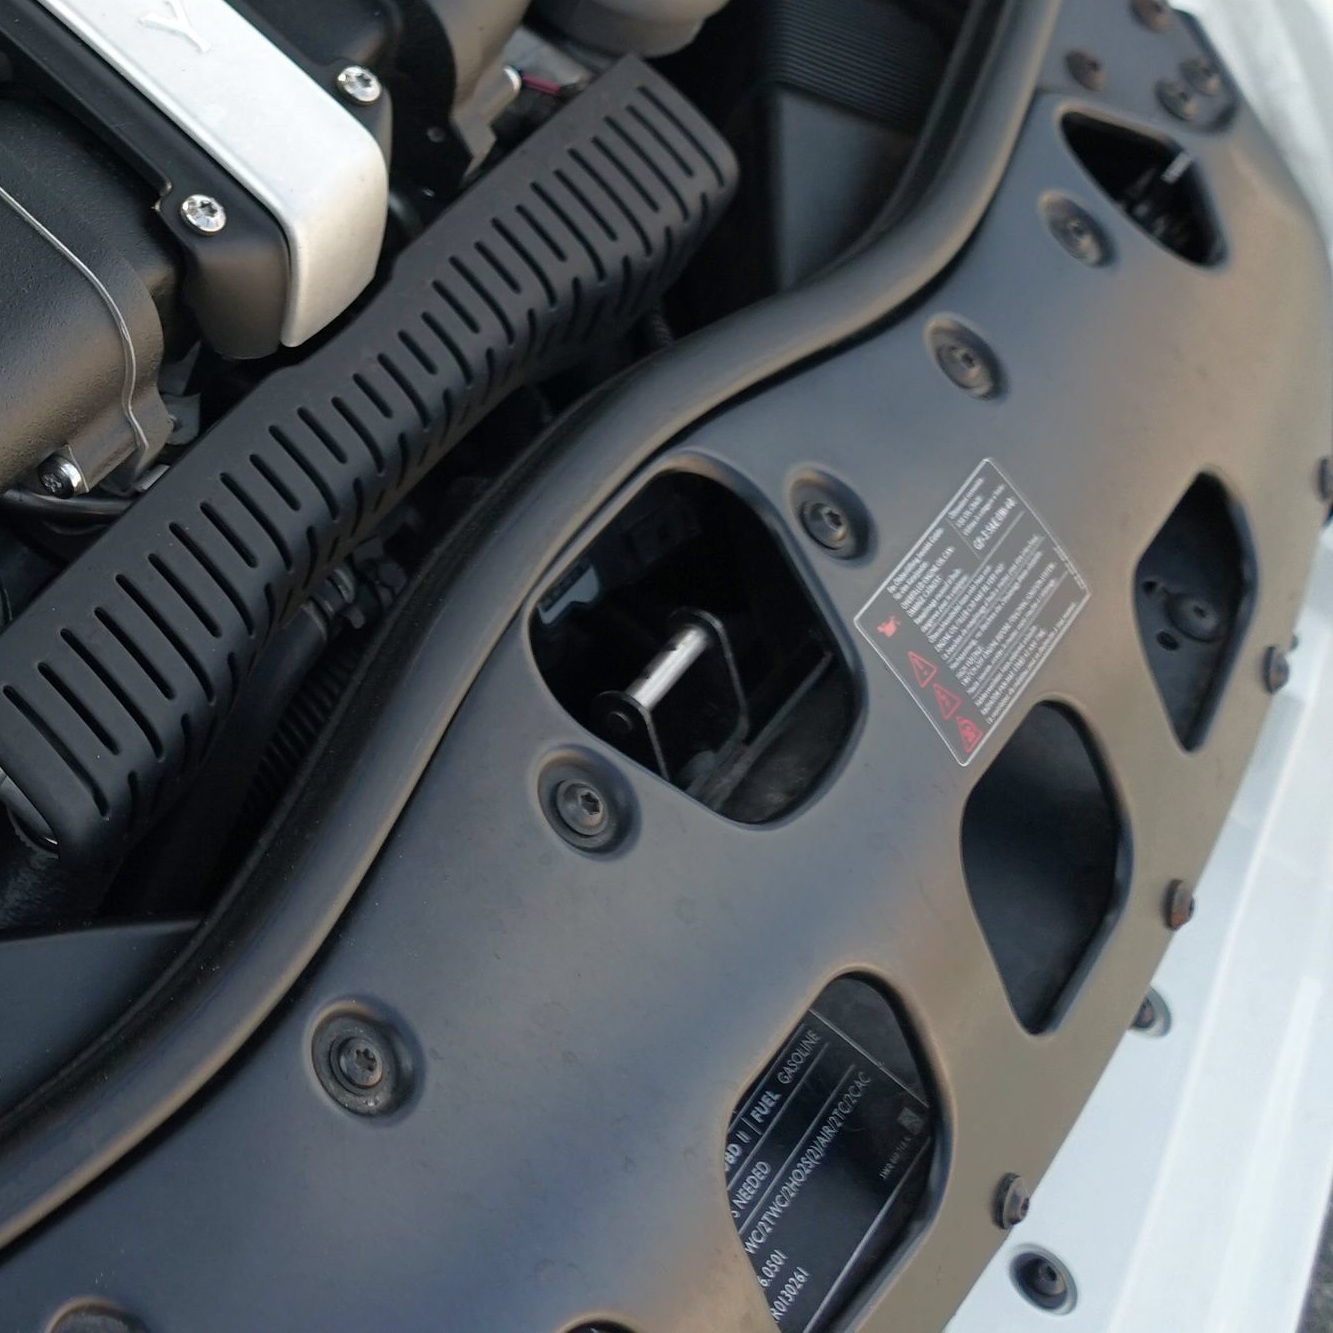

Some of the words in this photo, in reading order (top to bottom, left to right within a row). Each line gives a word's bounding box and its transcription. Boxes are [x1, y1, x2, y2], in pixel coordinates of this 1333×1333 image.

[750, 1090, 782, 1123] FUEL
[776, 1029, 821, 1084] GASOLINE
[732, 1161, 772, 1206] NEEDED
